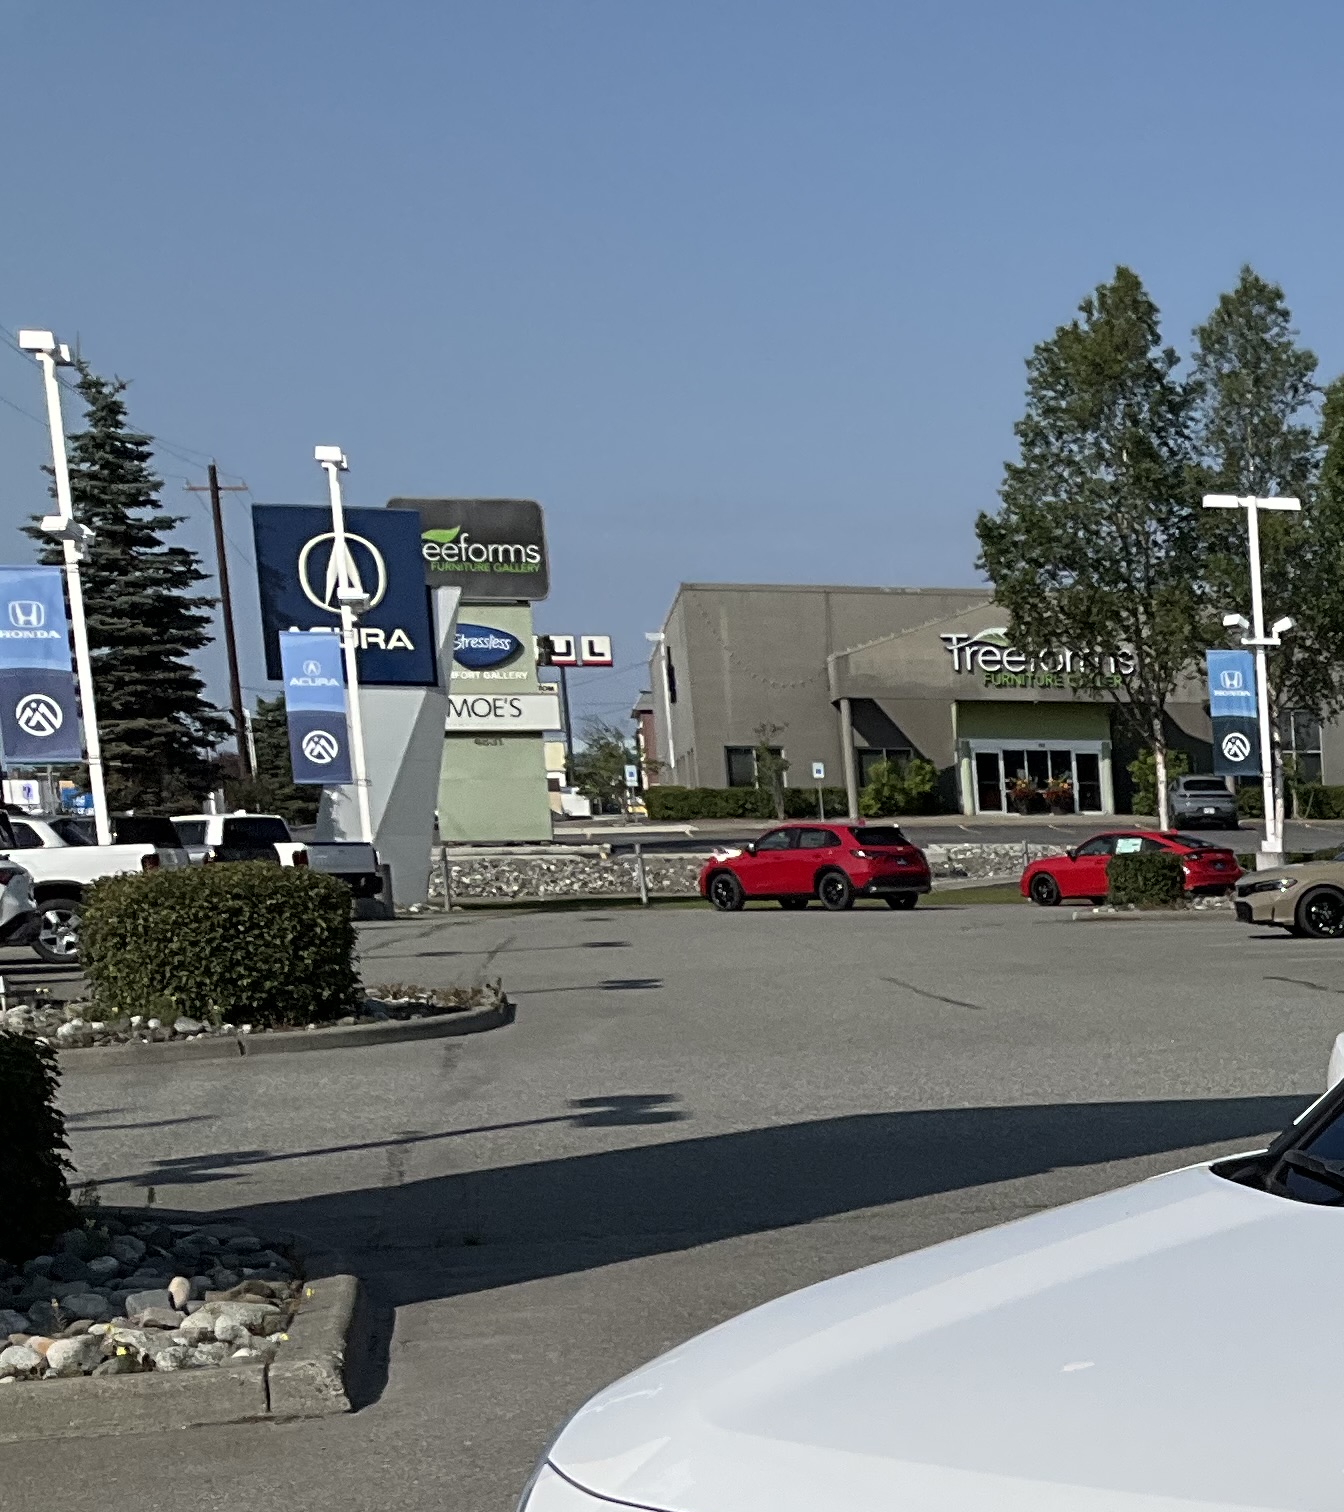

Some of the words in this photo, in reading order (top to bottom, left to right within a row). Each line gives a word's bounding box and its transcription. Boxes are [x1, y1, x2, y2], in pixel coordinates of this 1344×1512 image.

[430, 562, 490, 572] FURNITURE
[493, 563, 540, 573] GALLERY
[0, 630, 61, 639] HONDA
[453, 632, 512, 650] Stressless
[483, 671, 528, 679] GALLERY
[984, 672, 1062, 687] FURNITURE
[290, 677, 340, 687] ACURA
[448, 697, 522, 718] MOE'S
